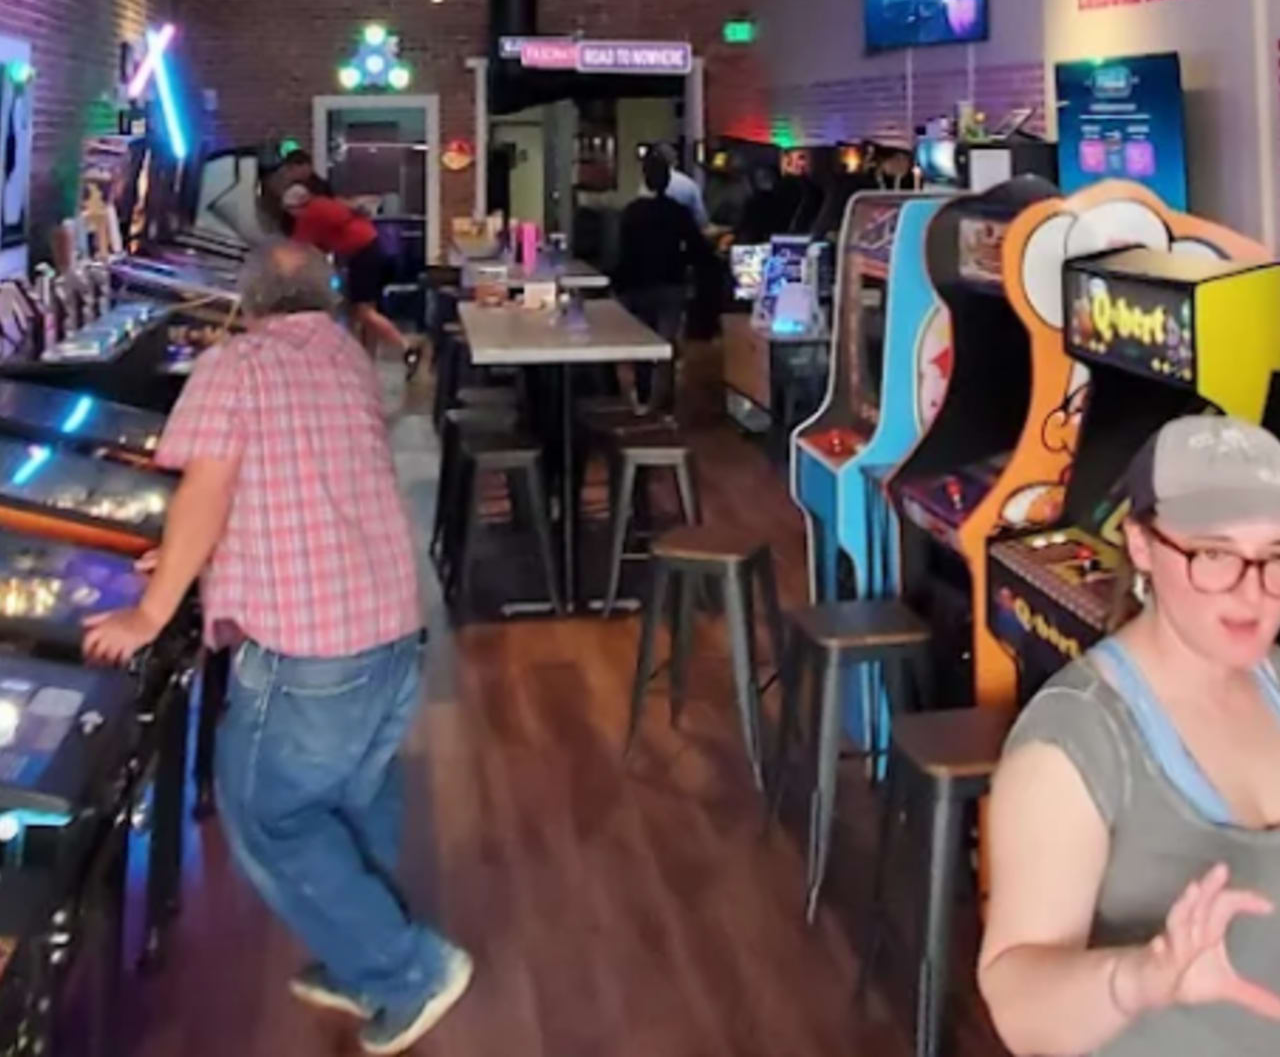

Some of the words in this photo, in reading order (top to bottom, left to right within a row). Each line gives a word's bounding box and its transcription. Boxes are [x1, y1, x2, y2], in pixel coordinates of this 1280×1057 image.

[584, 48, 614, 65] ROAD
[617, 48, 630, 65] TO
[632, 48, 684, 66] NOWHERE
